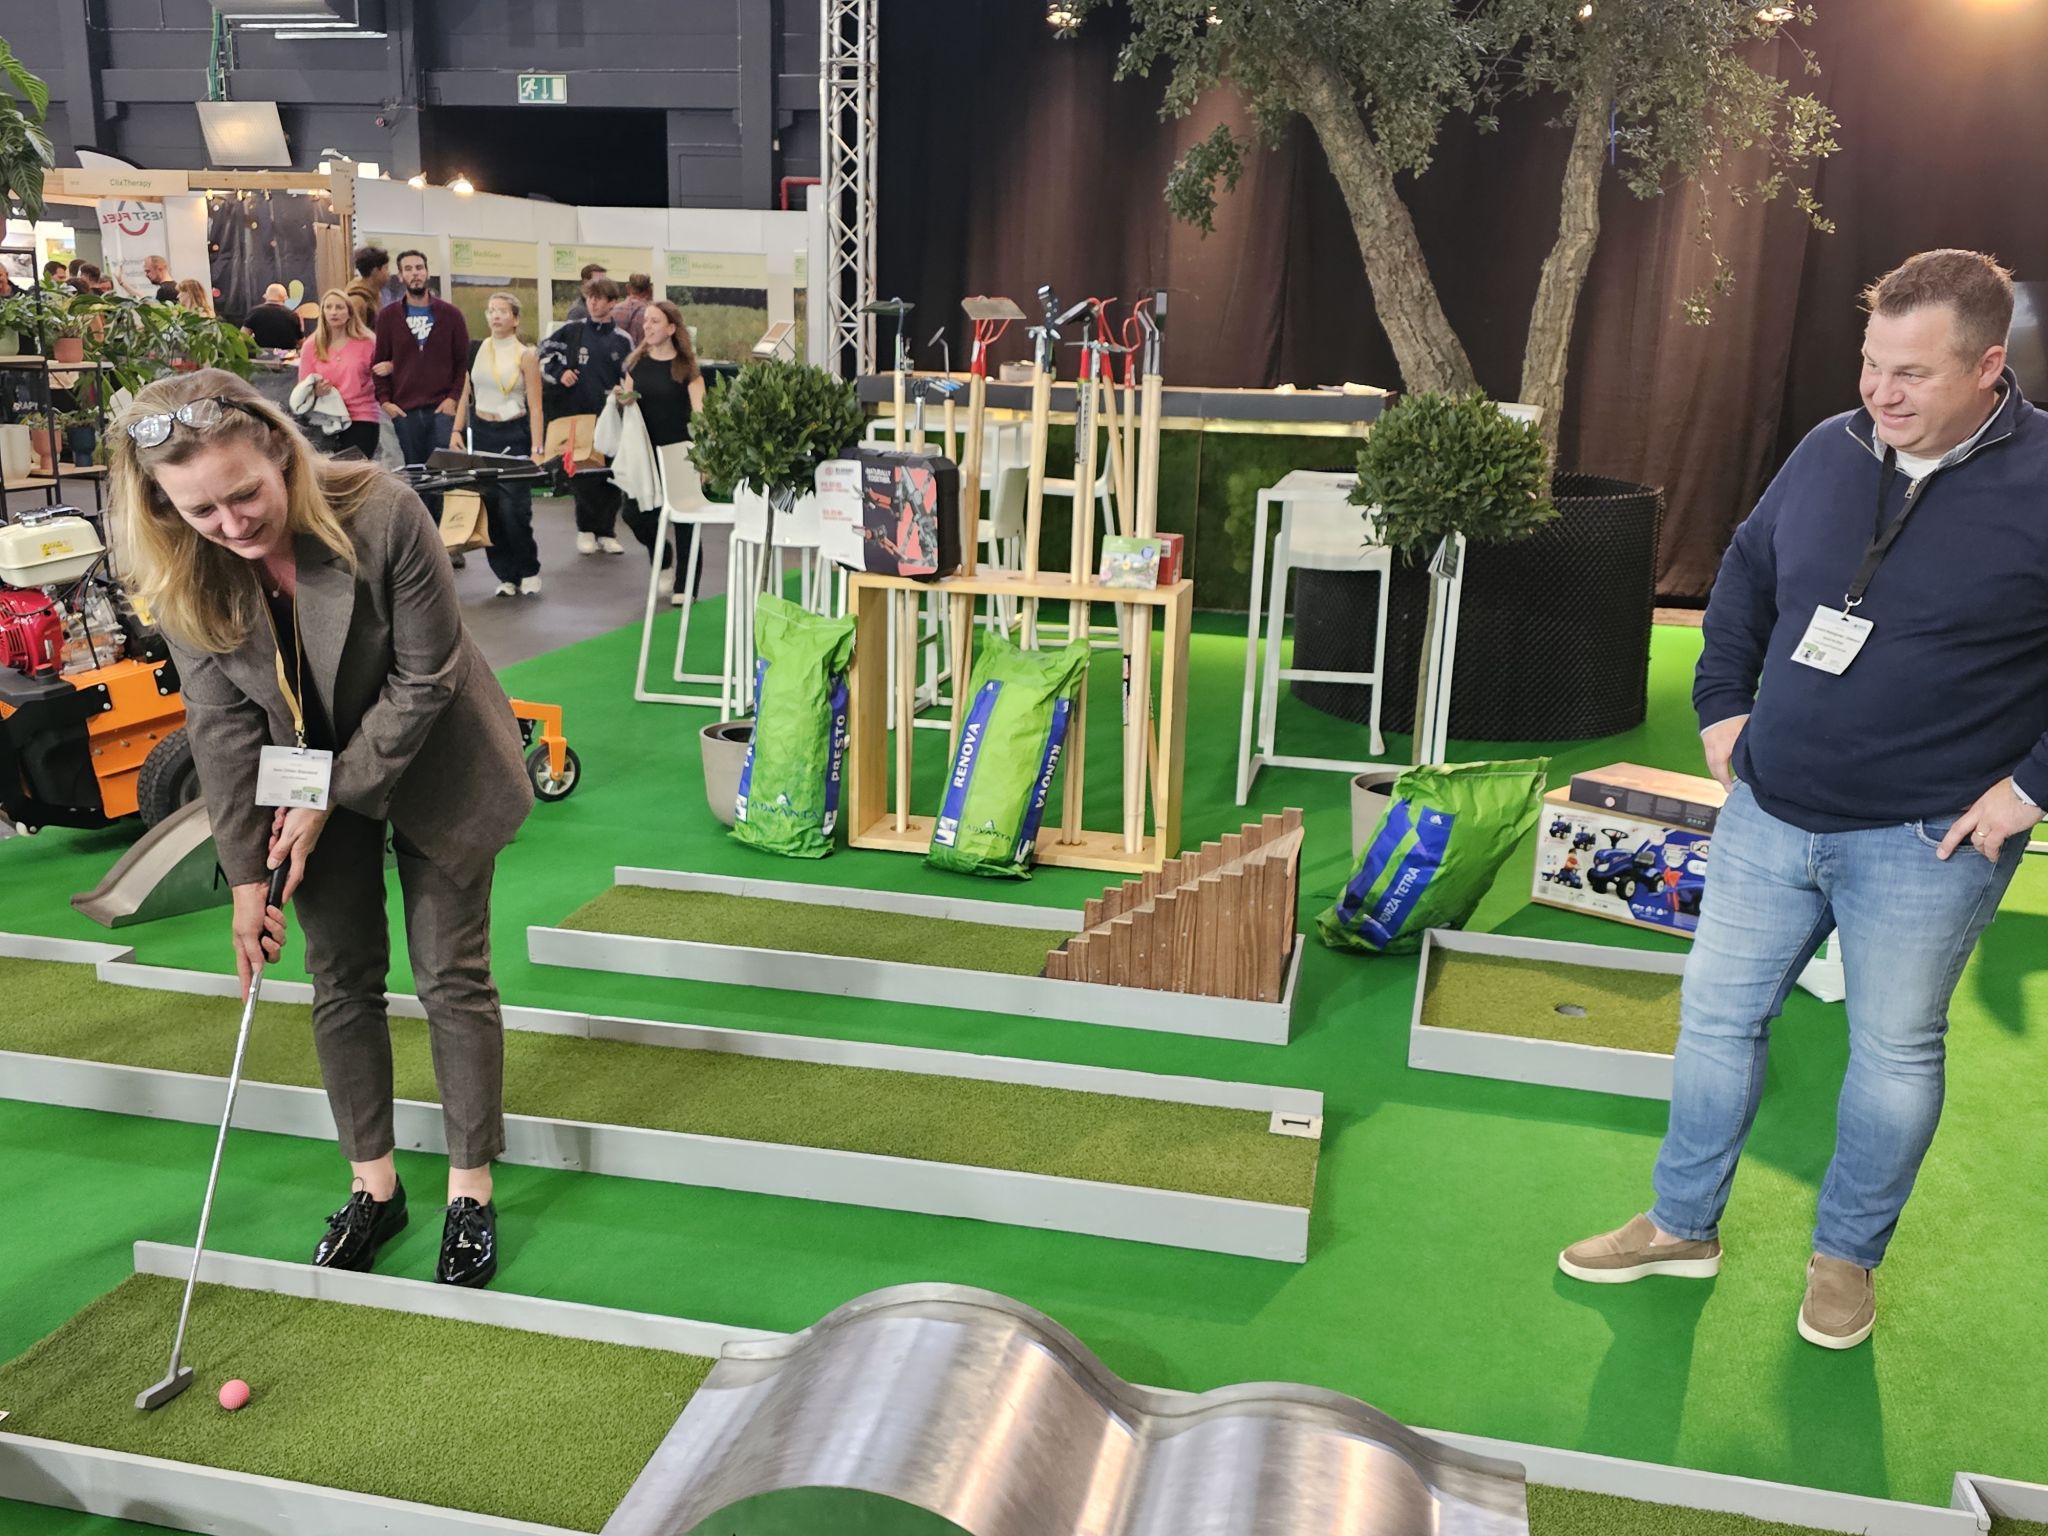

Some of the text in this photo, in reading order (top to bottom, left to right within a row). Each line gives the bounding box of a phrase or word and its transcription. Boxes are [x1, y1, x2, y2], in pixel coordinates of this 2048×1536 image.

[831, 714, 846, 782] PRESTO
[953, 722, 981, 789] RENOVA
[1035, 744, 1062, 809] RENOVA
[1378, 866, 1421, 925] FORZA TETRA
